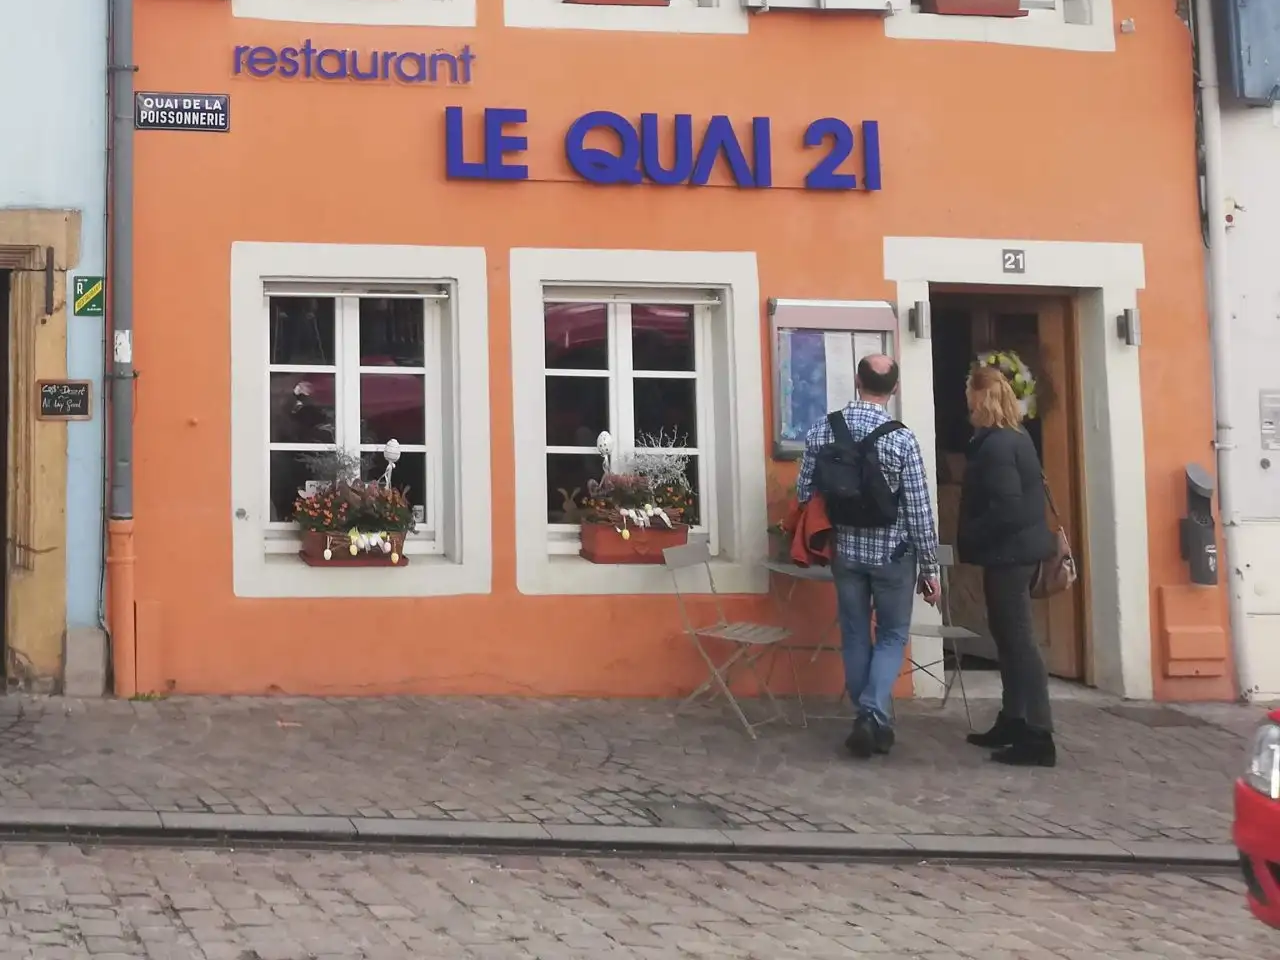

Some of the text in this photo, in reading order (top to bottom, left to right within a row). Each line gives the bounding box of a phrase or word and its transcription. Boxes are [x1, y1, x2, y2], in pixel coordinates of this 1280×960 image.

[232, 38, 477, 84] restaurant
[143, 97, 222, 111] QUAI DE LA
[140, 110, 226, 126] POISSONNERIE
[444, 105, 882, 192] LE QUAI 21
[1004, 253, 1024, 269] 21
[76, 282, 84, 295] R
